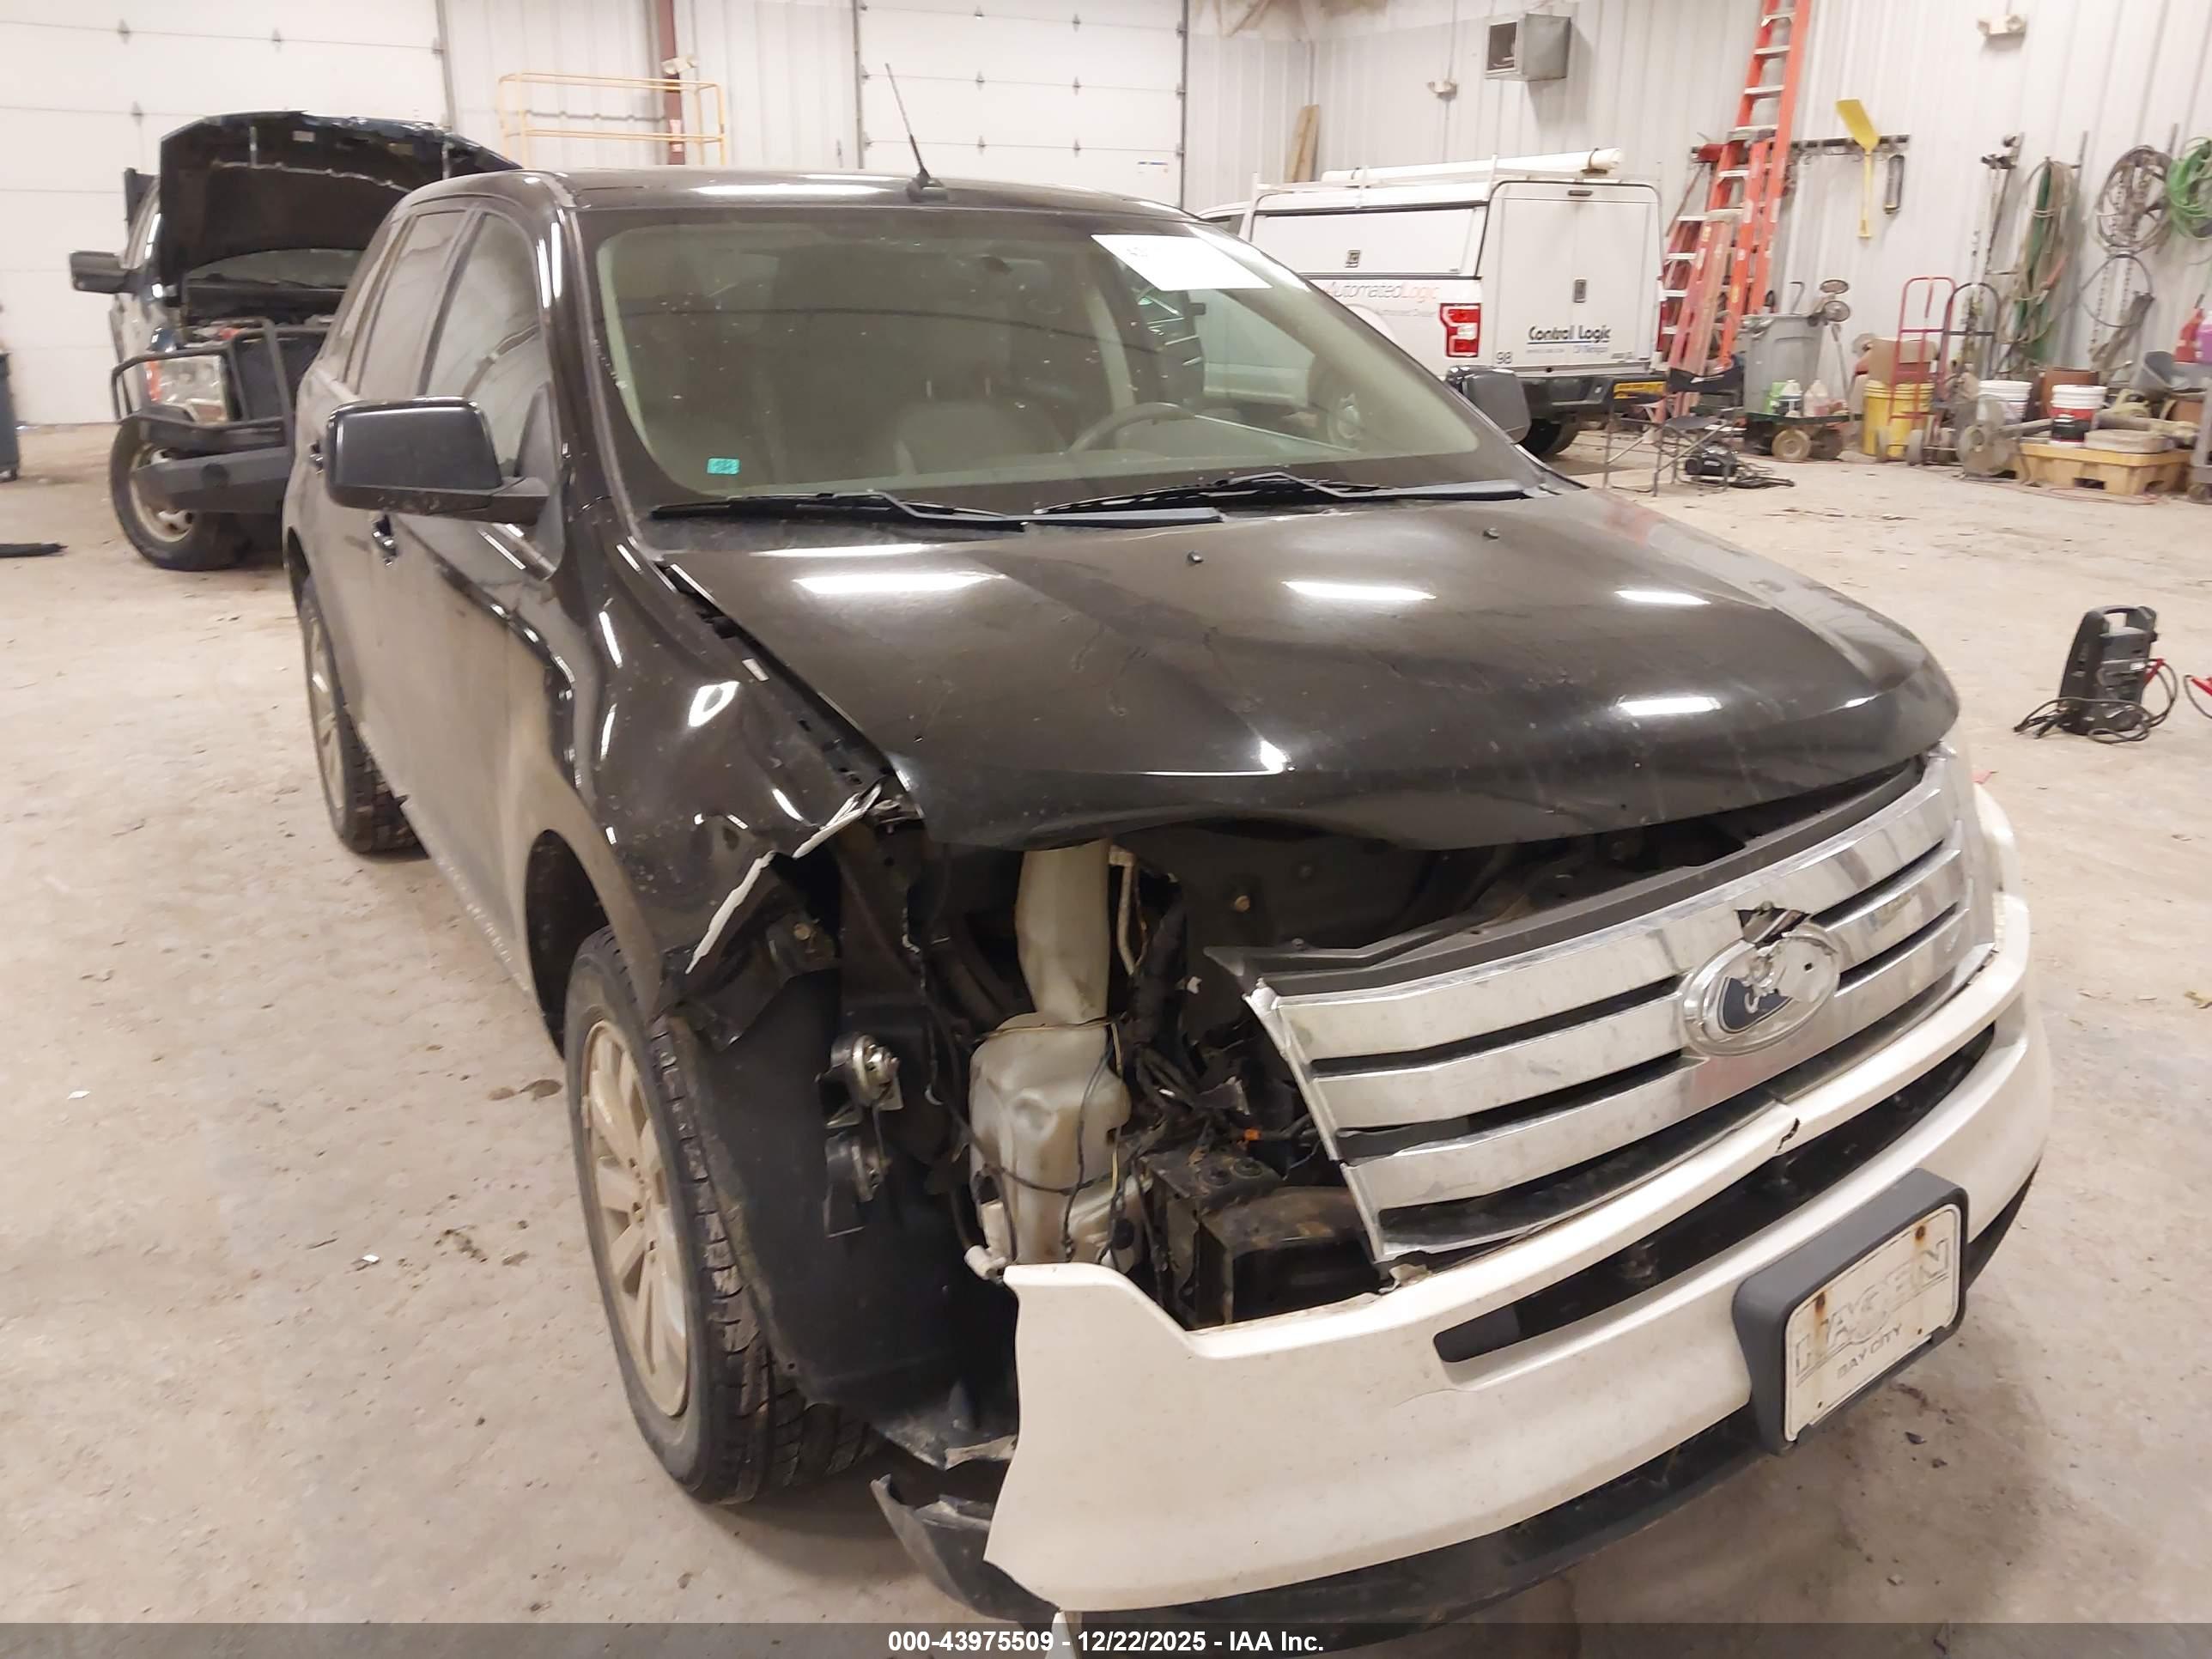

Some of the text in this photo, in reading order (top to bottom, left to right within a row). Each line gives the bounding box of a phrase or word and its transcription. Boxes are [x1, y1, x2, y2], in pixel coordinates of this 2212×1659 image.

[1528, 325, 1612, 343] Control Logic
[1496, 350, 1514, 365] 98
[1837, 1322, 1903, 1379] BAY CITY
